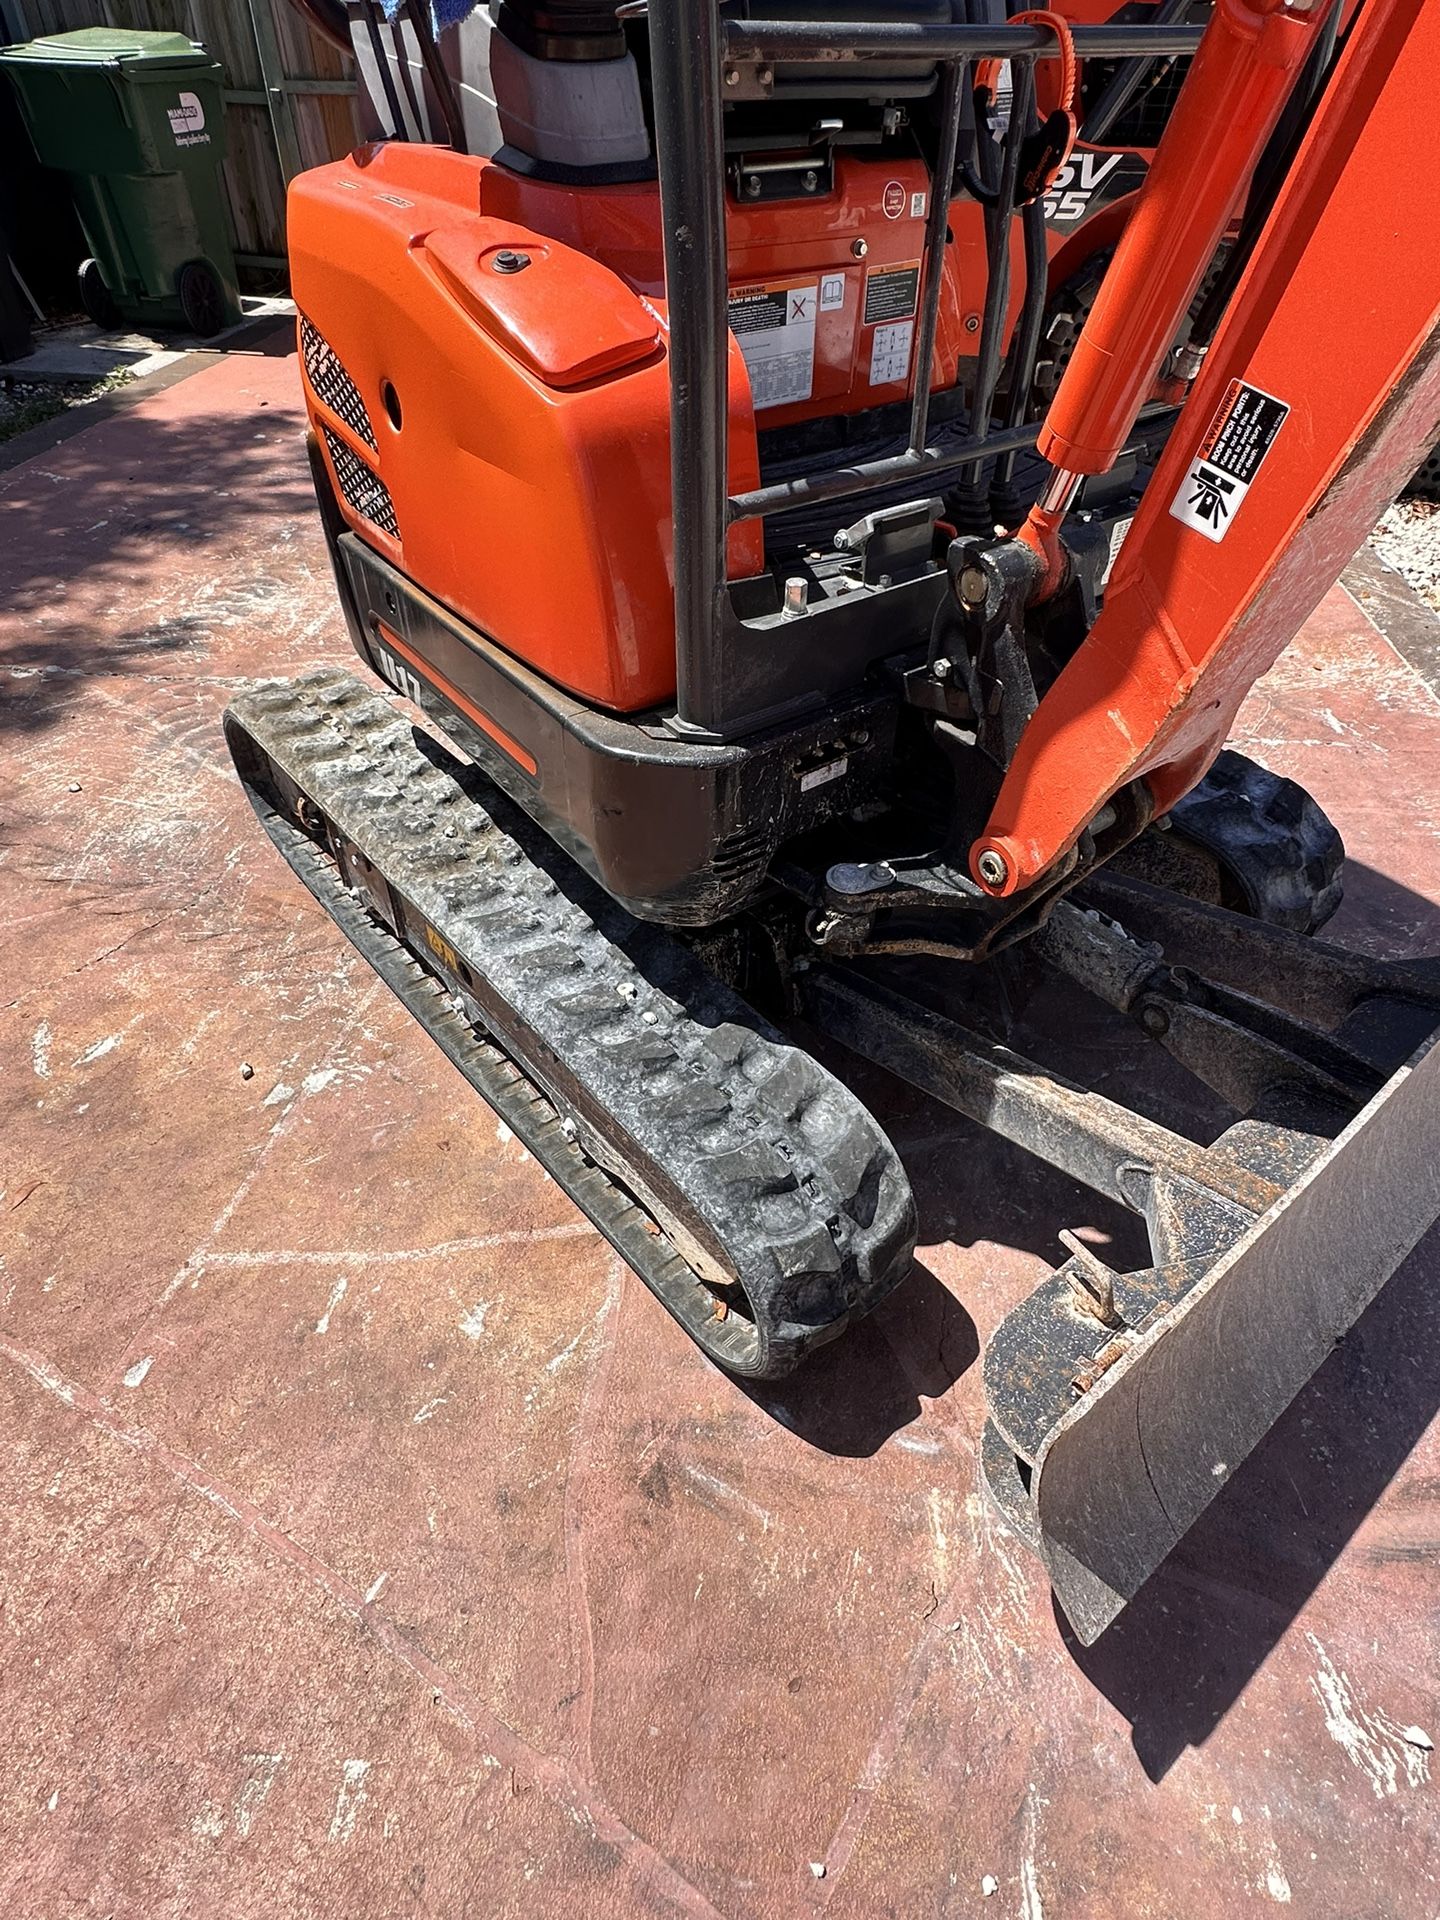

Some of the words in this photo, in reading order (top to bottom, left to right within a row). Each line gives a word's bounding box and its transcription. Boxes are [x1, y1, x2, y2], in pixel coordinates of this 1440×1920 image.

[1209, 388, 1237, 440] WARNING
[1211, 441, 1225, 461] BOOM
[1221, 420, 1236, 441] PINCH
[1232, 391, 1250, 419] POINTS:
[1220, 448, 1232, 466] Keep
[1230, 435, 1239, 447] out
[1236, 426, 1243, 434] of
[1240, 412, 1250, 426] this
[1227, 454, 1237, 470] area
[1235, 445, 1242, 453] to
[1240, 425, 1252, 445] avoid
[1250, 399, 1266, 425] serious
[1234, 444, 1251, 474] personal
[1248, 424, 1262, 444] injury
[1241, 469, 1247, 477] or
[1245, 448, 1259, 468] death.
